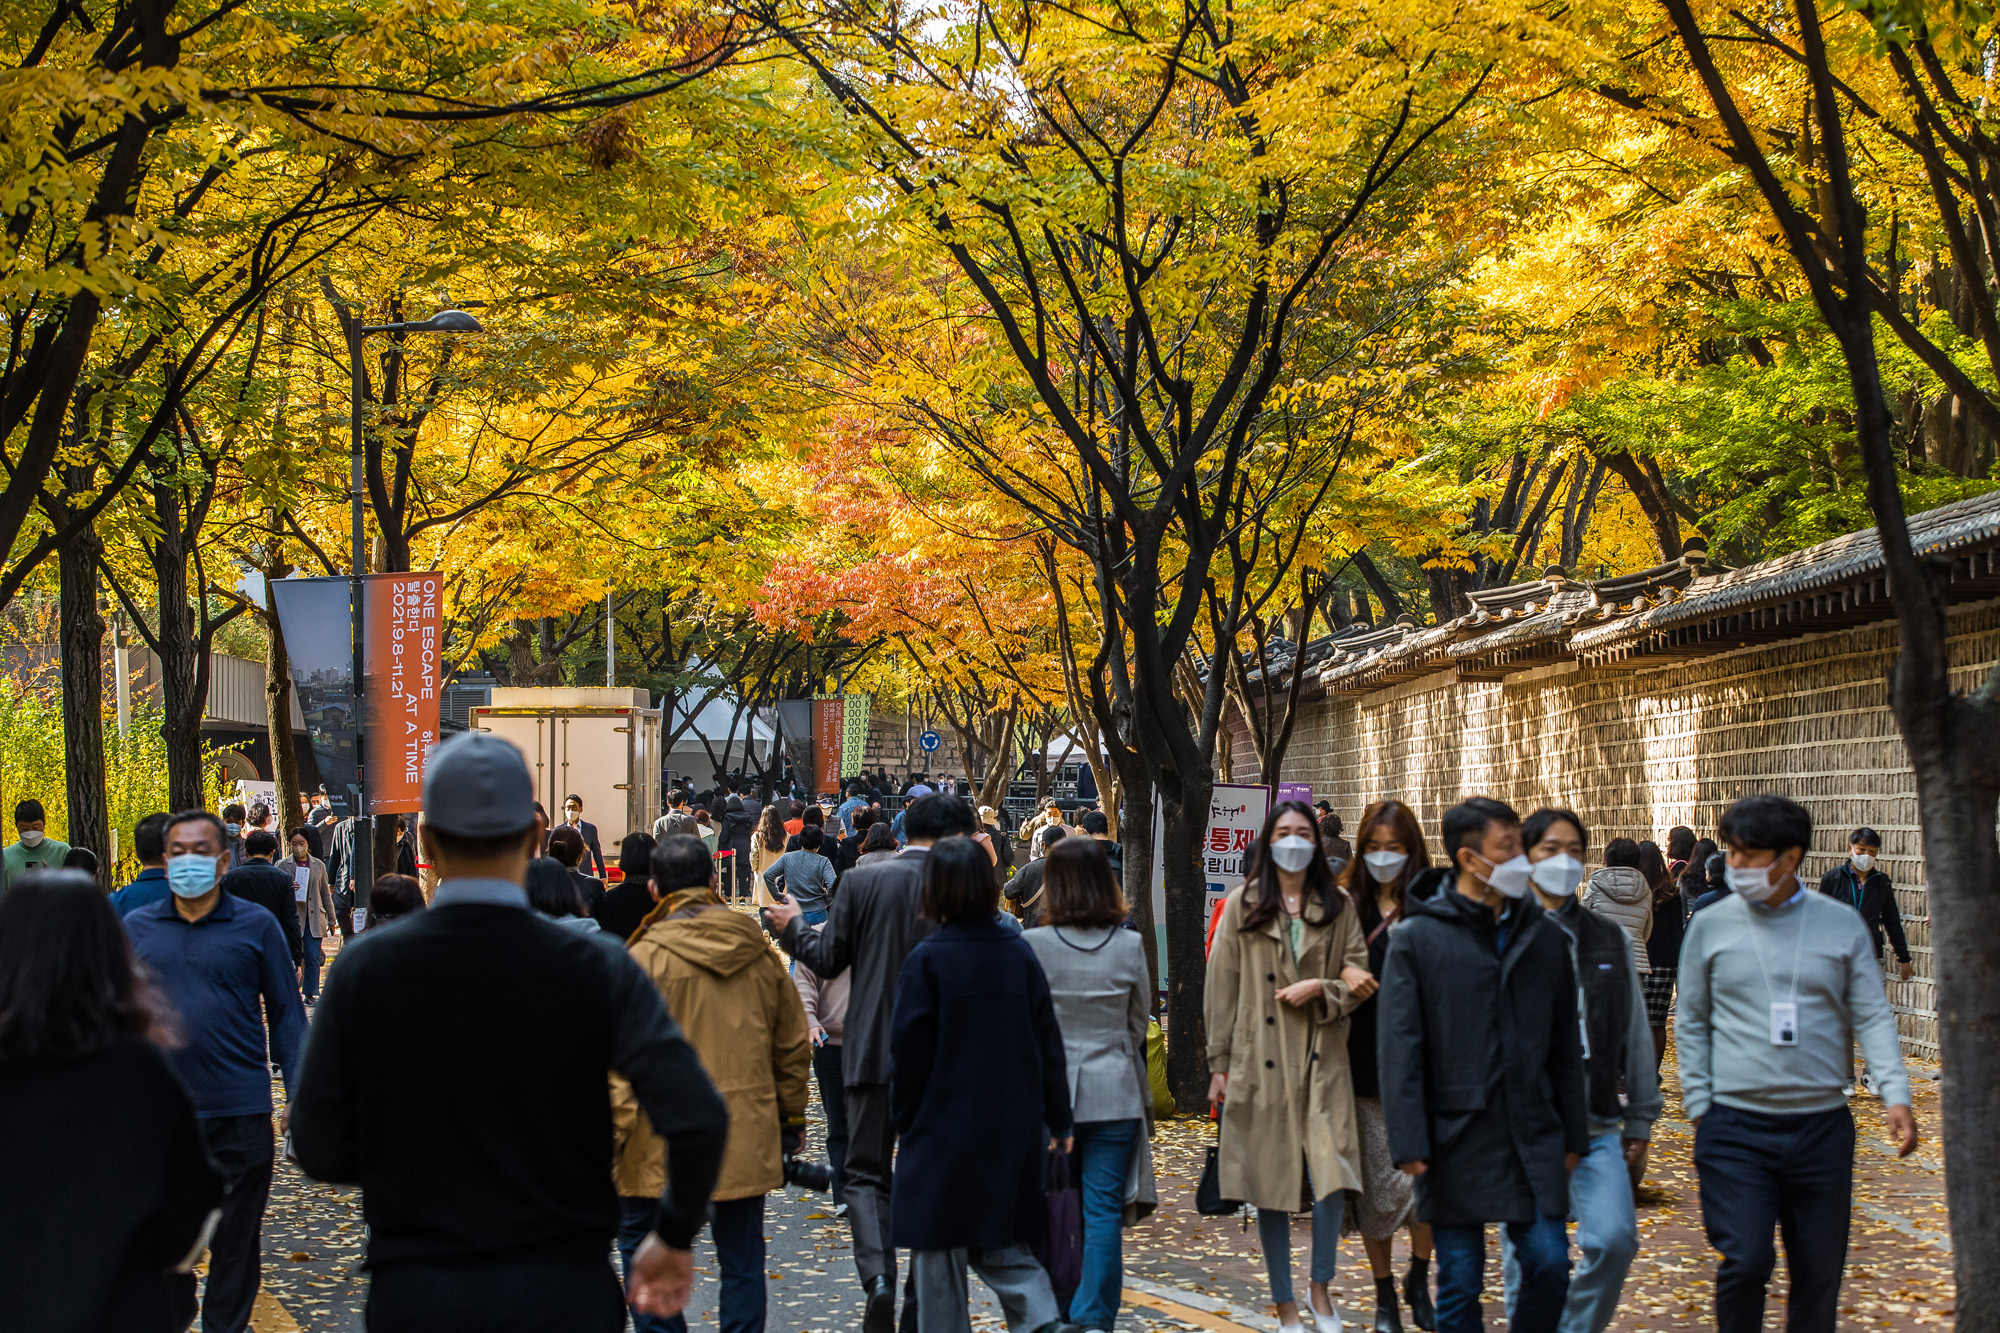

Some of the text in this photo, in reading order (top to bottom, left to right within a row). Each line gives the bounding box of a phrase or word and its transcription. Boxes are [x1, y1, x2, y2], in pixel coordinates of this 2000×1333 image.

[392, 582, 405, 698] 2021.9.8-11.21
[406, 581, 420, 633] 탈출한다
[421, 580, 435, 700] ONE ESCAPE
[406, 693, 418, 784] AT A TIME
[1203, 827, 1255, 853] 통제
